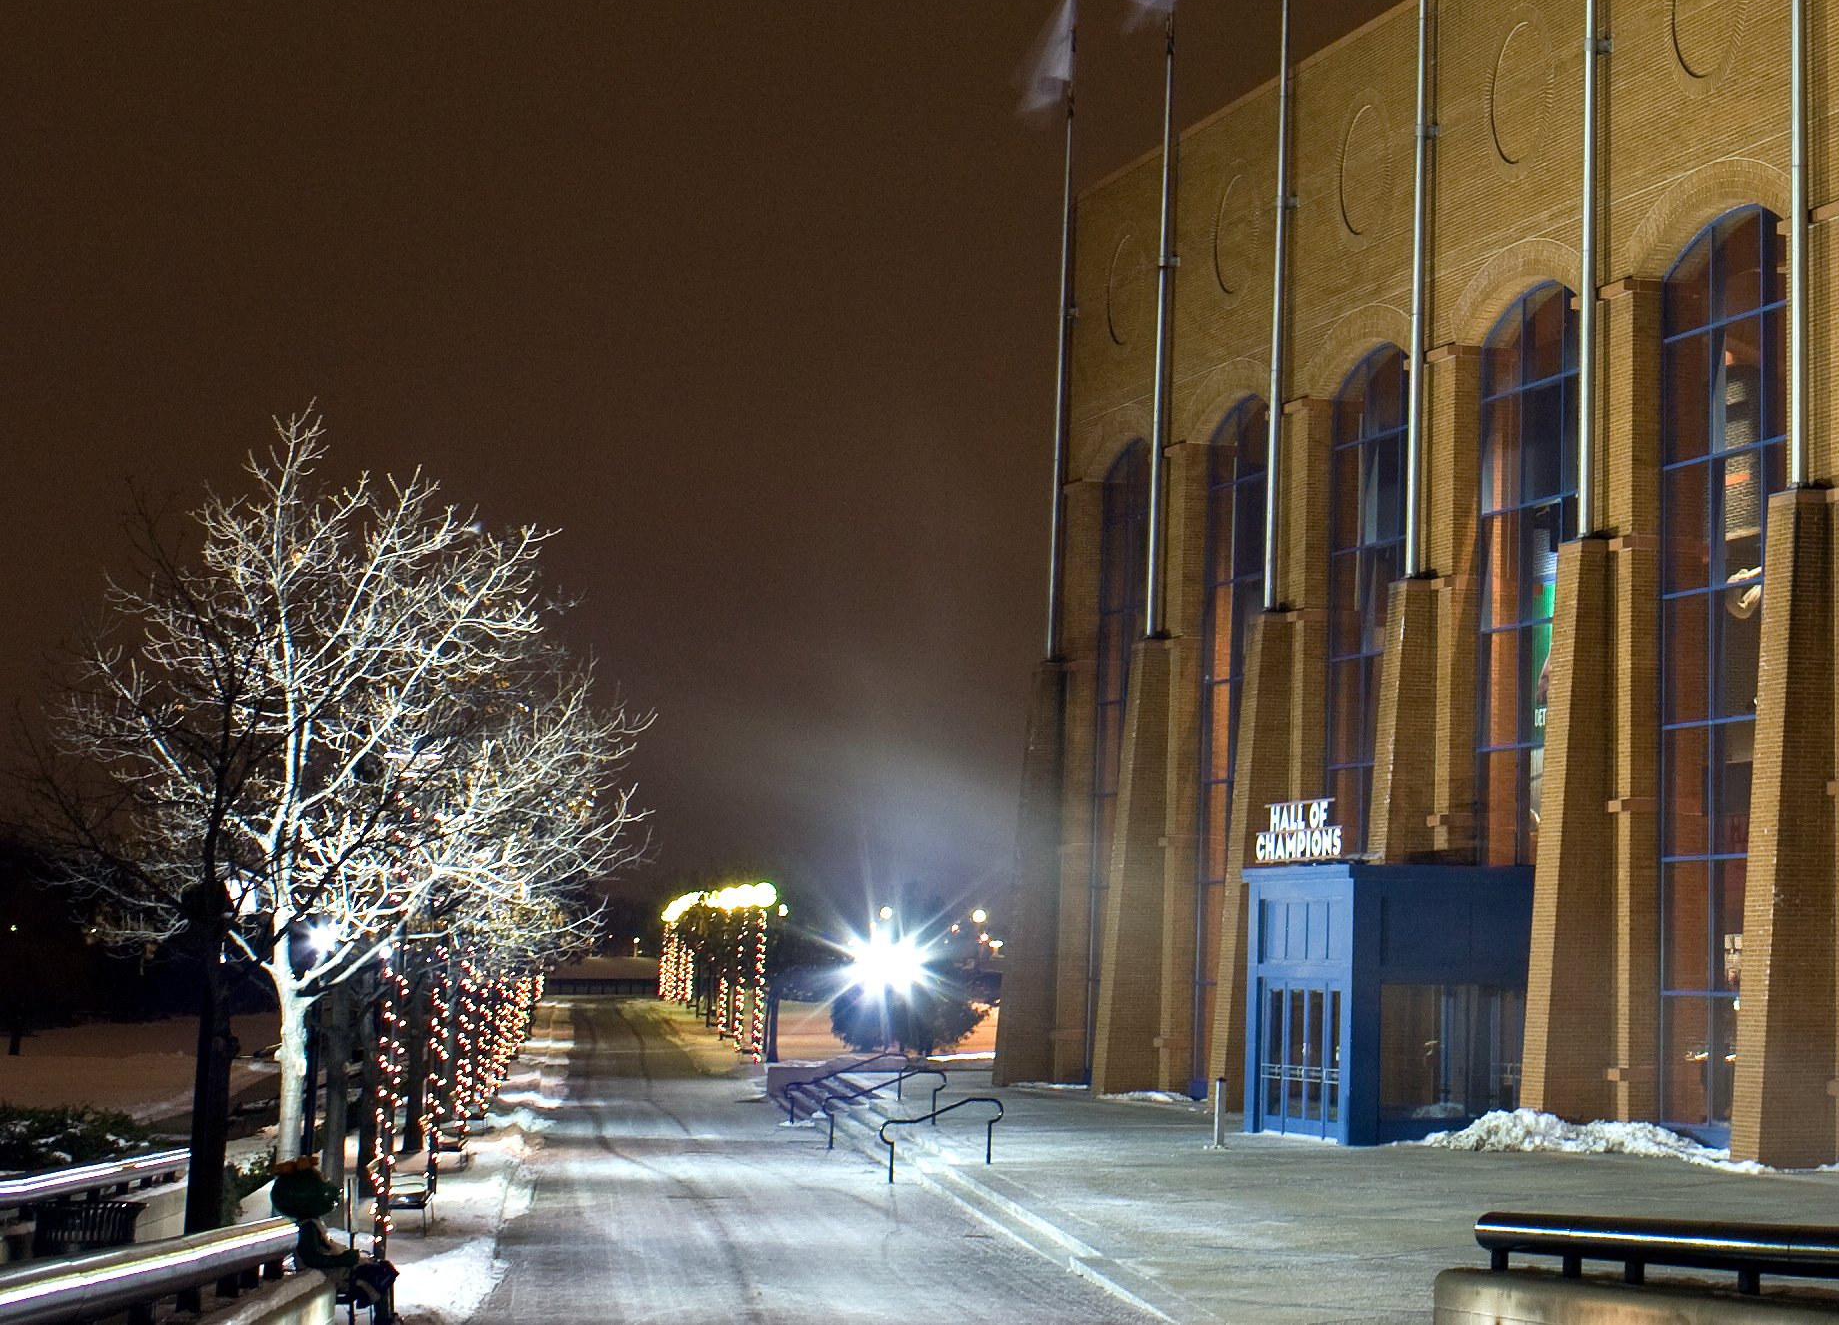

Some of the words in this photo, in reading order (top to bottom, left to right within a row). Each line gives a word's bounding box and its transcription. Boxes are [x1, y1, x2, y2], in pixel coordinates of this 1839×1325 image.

[1270, 803, 1306, 832] HALL
[1309, 800, 1329, 829] OF
[1256, 828, 1342, 860] CHAMPIONS
